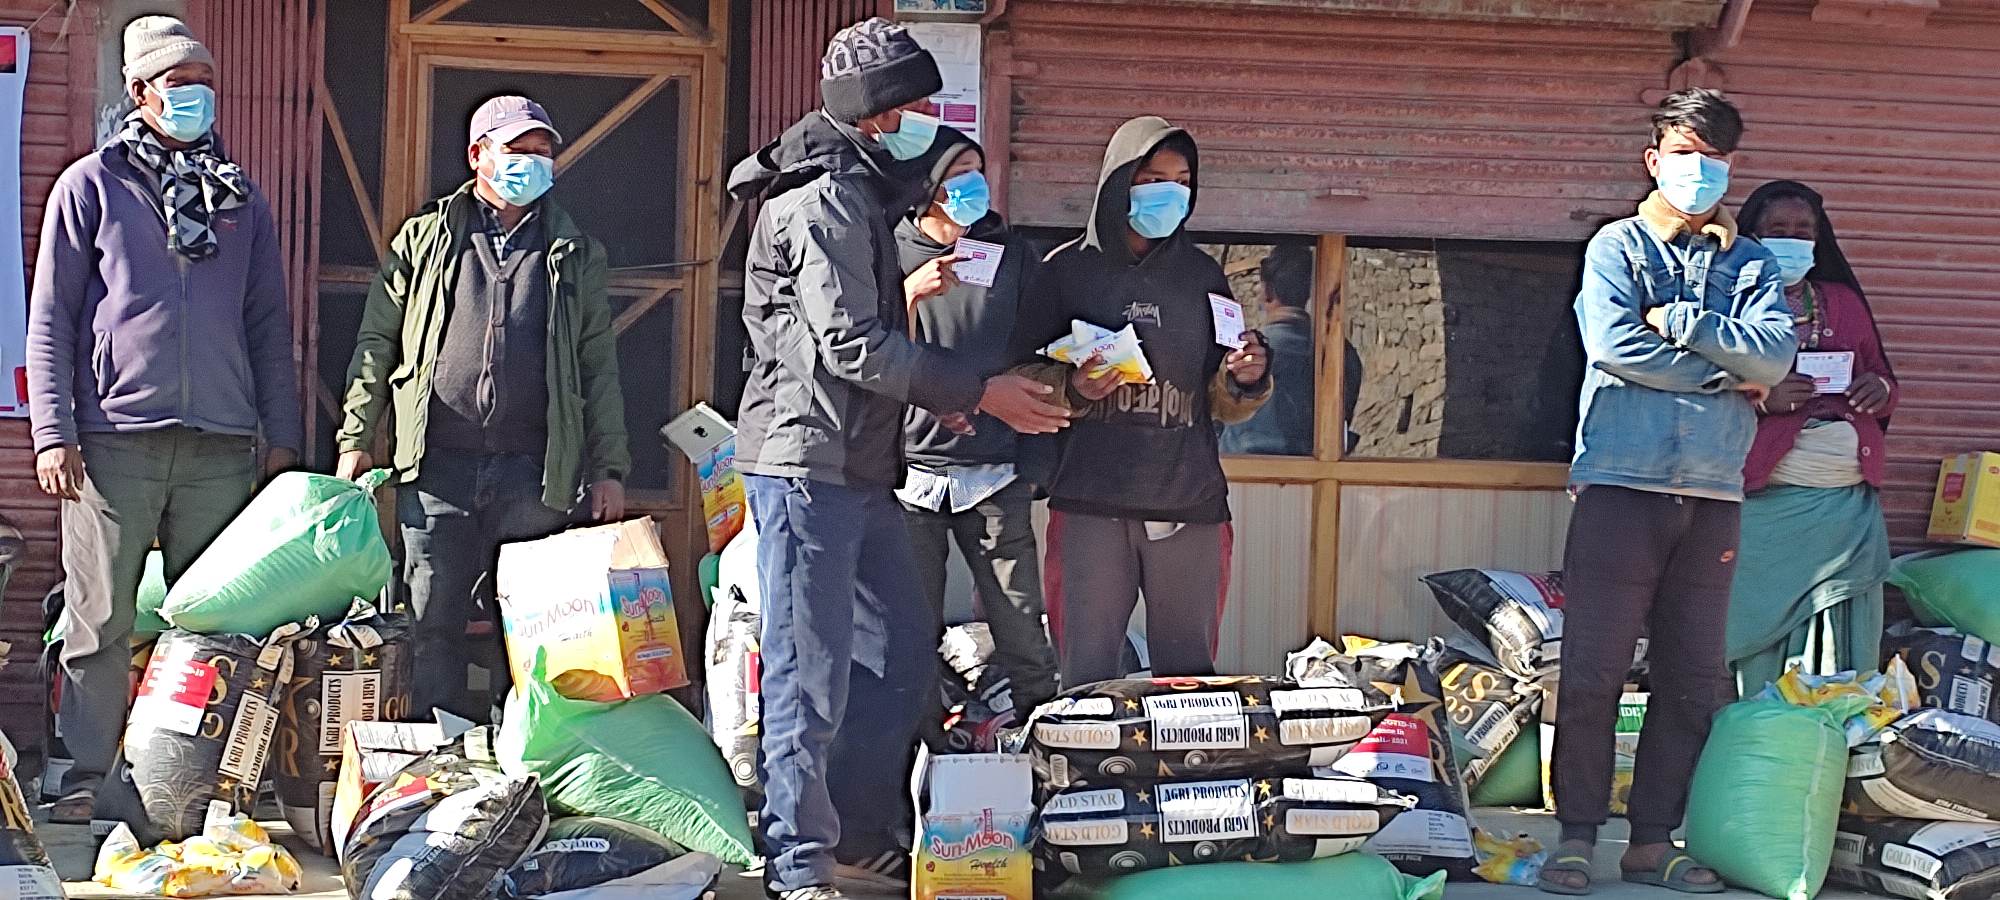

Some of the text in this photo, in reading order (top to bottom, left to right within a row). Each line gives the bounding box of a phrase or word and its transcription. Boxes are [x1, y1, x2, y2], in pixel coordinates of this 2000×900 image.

[362, 678, 375, 700] AGRI
[1153, 696, 1233, 709] AGRI PRODUCTS
[325, 678, 342, 747] AGRI PRODUCTS
[226, 700, 258, 770] AGRI PRODUCTS
[1074, 729, 1114, 743] GOLD
[1160, 727, 1240, 743] AGRI PRODUCTS
[248, 714, 275, 783] AGRI PRODUCTS
[1048, 793, 1119, 809] OLD STAR
[1164, 785, 1246, 801] AGRI PRODUCTS
[1082, 824, 1121, 840] GOLD
[1168, 816, 1249, 835] AGRI PRODUCTS
